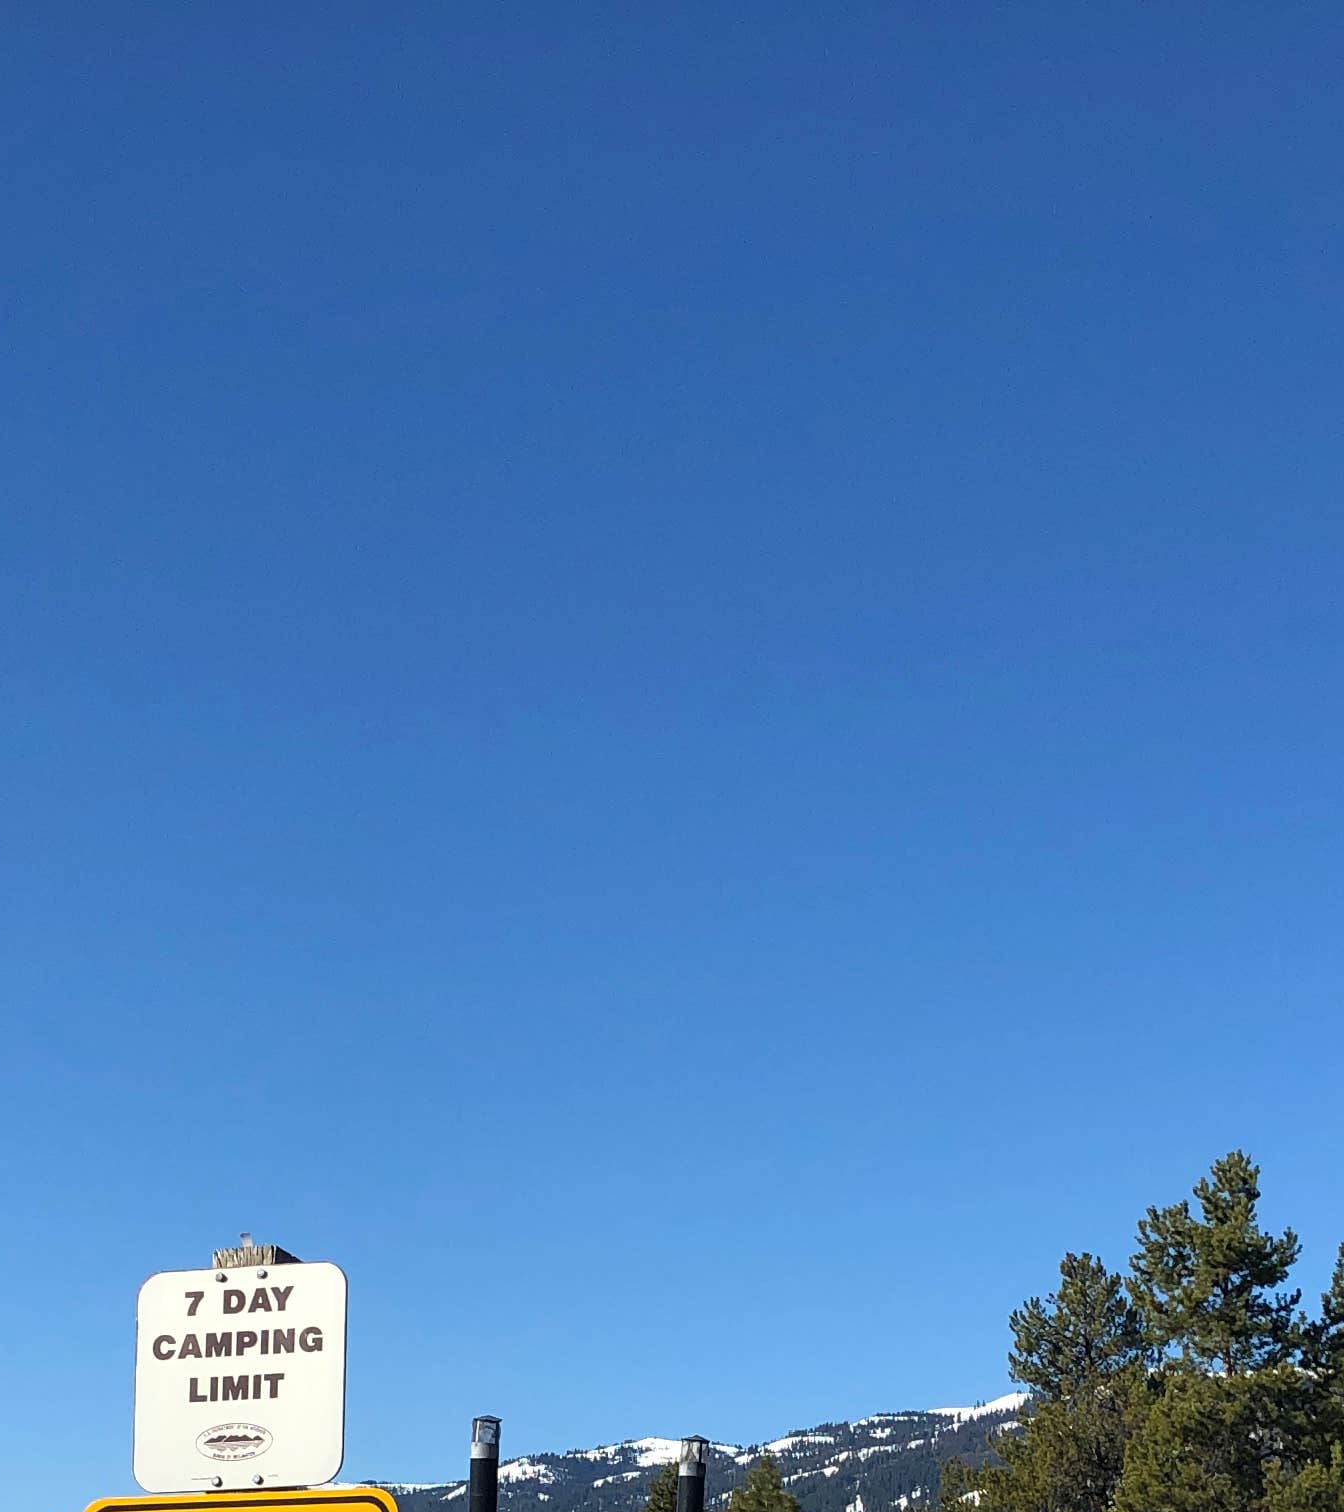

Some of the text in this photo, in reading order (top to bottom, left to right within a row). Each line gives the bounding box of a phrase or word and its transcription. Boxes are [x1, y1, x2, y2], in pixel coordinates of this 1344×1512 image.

[184, 1285, 295, 1317] 7 DAY
[152, 1326, 324, 1361] CAMPING
[188, 1372, 285, 1403] LIMIT
